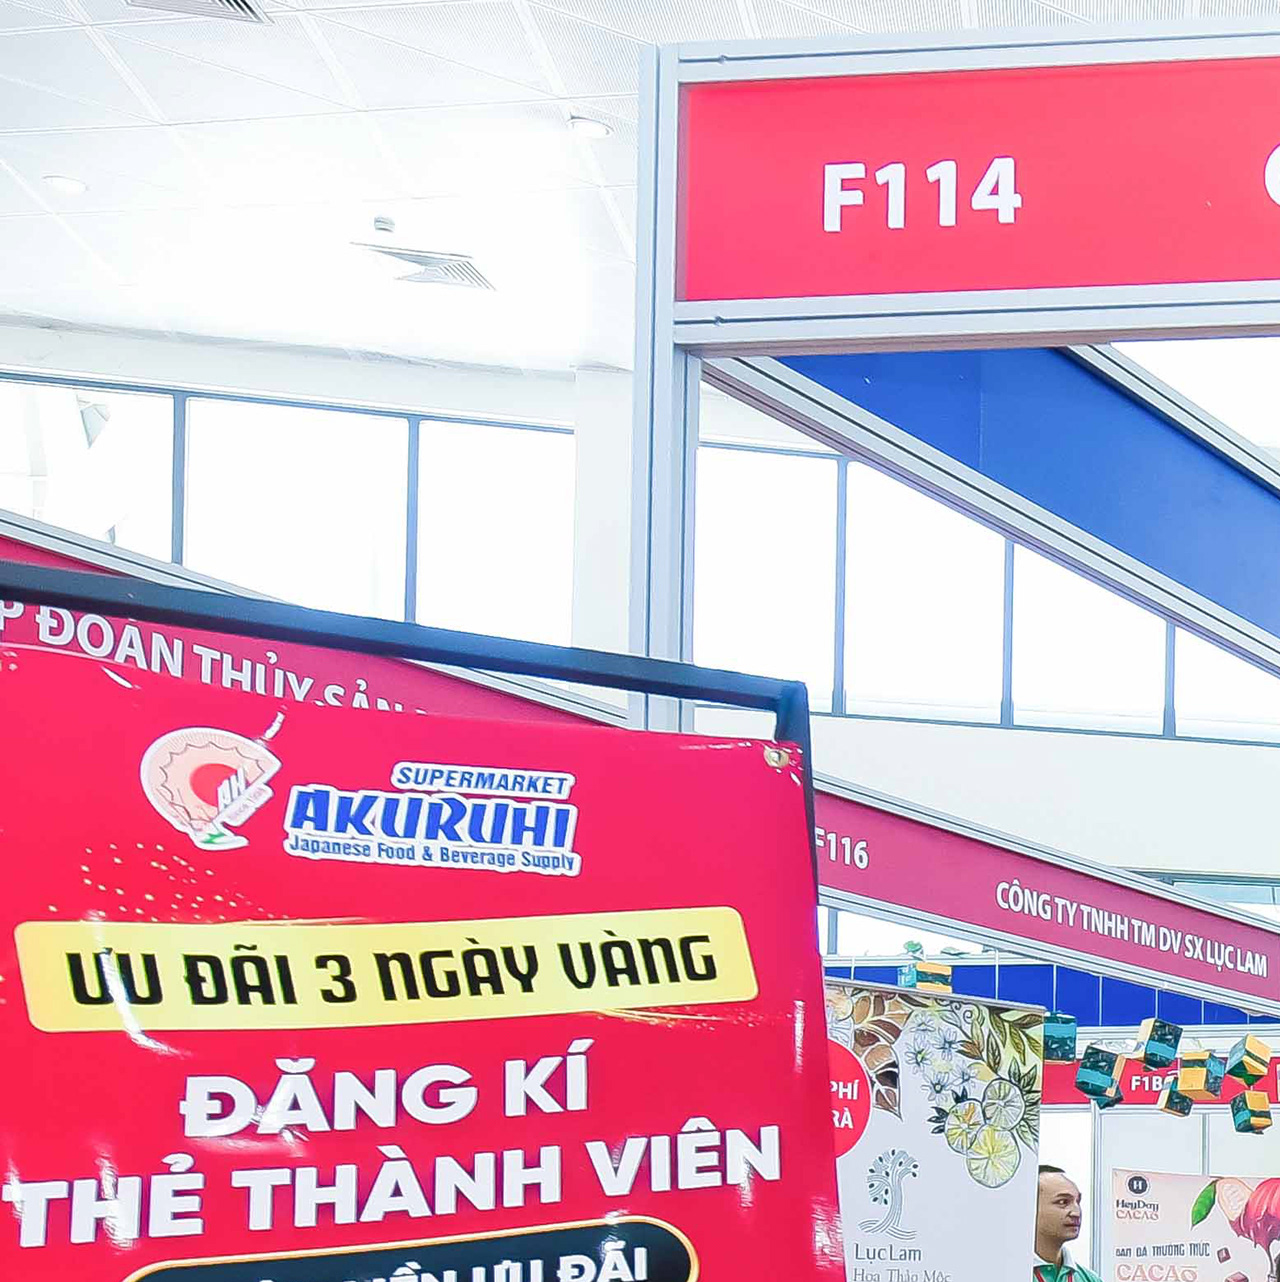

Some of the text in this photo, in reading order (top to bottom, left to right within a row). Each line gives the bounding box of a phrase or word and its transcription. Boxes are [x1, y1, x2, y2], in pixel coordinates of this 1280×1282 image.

[821, 156, 1023, 233] F114
[289, 788, 571, 848] AKURUHI
[396, 765, 568, 796] SUPERMARKET
[290, 834, 575, 872] Japanese Food & Beverage Supply
[66, 926, 718, 1006] ƯU ĐÃI 3 NGÀY VÀNG
[996, 878, 1268, 978] CÔNG TY TNHH TM DV SX LỤC LAM
[180, 1039, 595, 1139] ĐĂNG KÍ
[3, 1118, 782, 1249] THẺ THÀNH VIÊN
